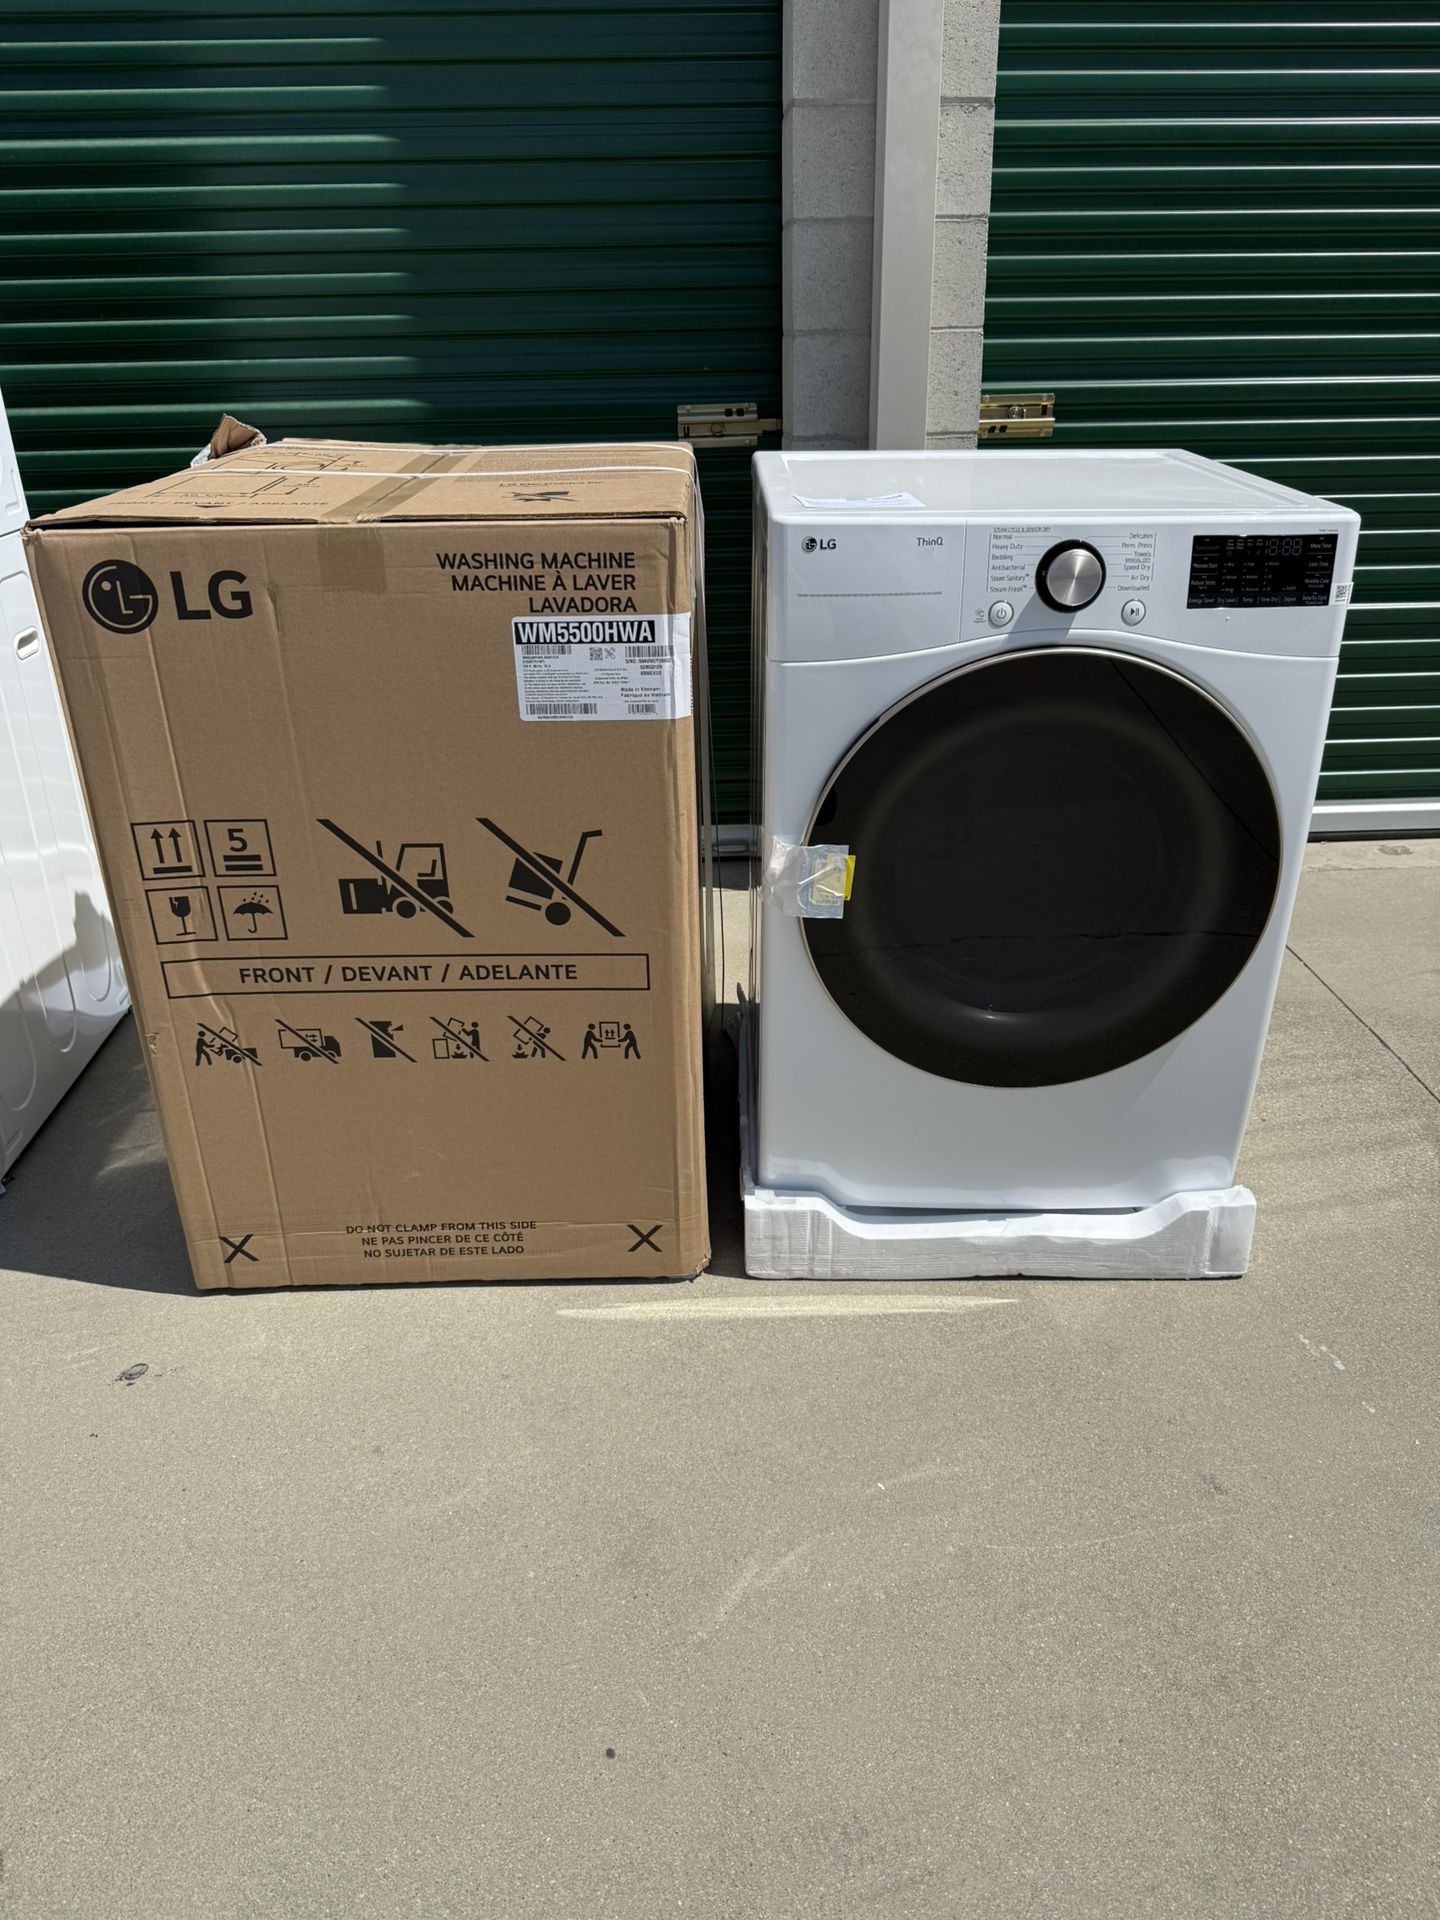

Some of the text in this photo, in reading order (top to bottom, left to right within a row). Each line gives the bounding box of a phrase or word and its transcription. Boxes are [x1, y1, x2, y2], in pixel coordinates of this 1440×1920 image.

[819, 539, 837, 550] LG
[916, 537, 944, 547] ThinQ
[1010, 543, 1024, 551] Duty
[436, 552, 636, 570] WASHING MACHINE
[451, 570, 636, 591] MACHINE À LAVER
[169, 569, 253, 620] LG
[528, 597, 637, 613] LAVADORA
[517, 620, 653, 644] WM5500HWA
[227, 828, 248, 852] 5
[239, 963, 578, 984] FRONT / DEVANT / ADELANTE
[345, 1220, 537, 1234] DO NOT CLAMP FROM THIS SIDE
[362, 1231, 524, 1246] NE PAS PINCER DE CE CÔTÉ
[364, 1245, 524, 1258] NO SUJETAR DE ESTE LADO
